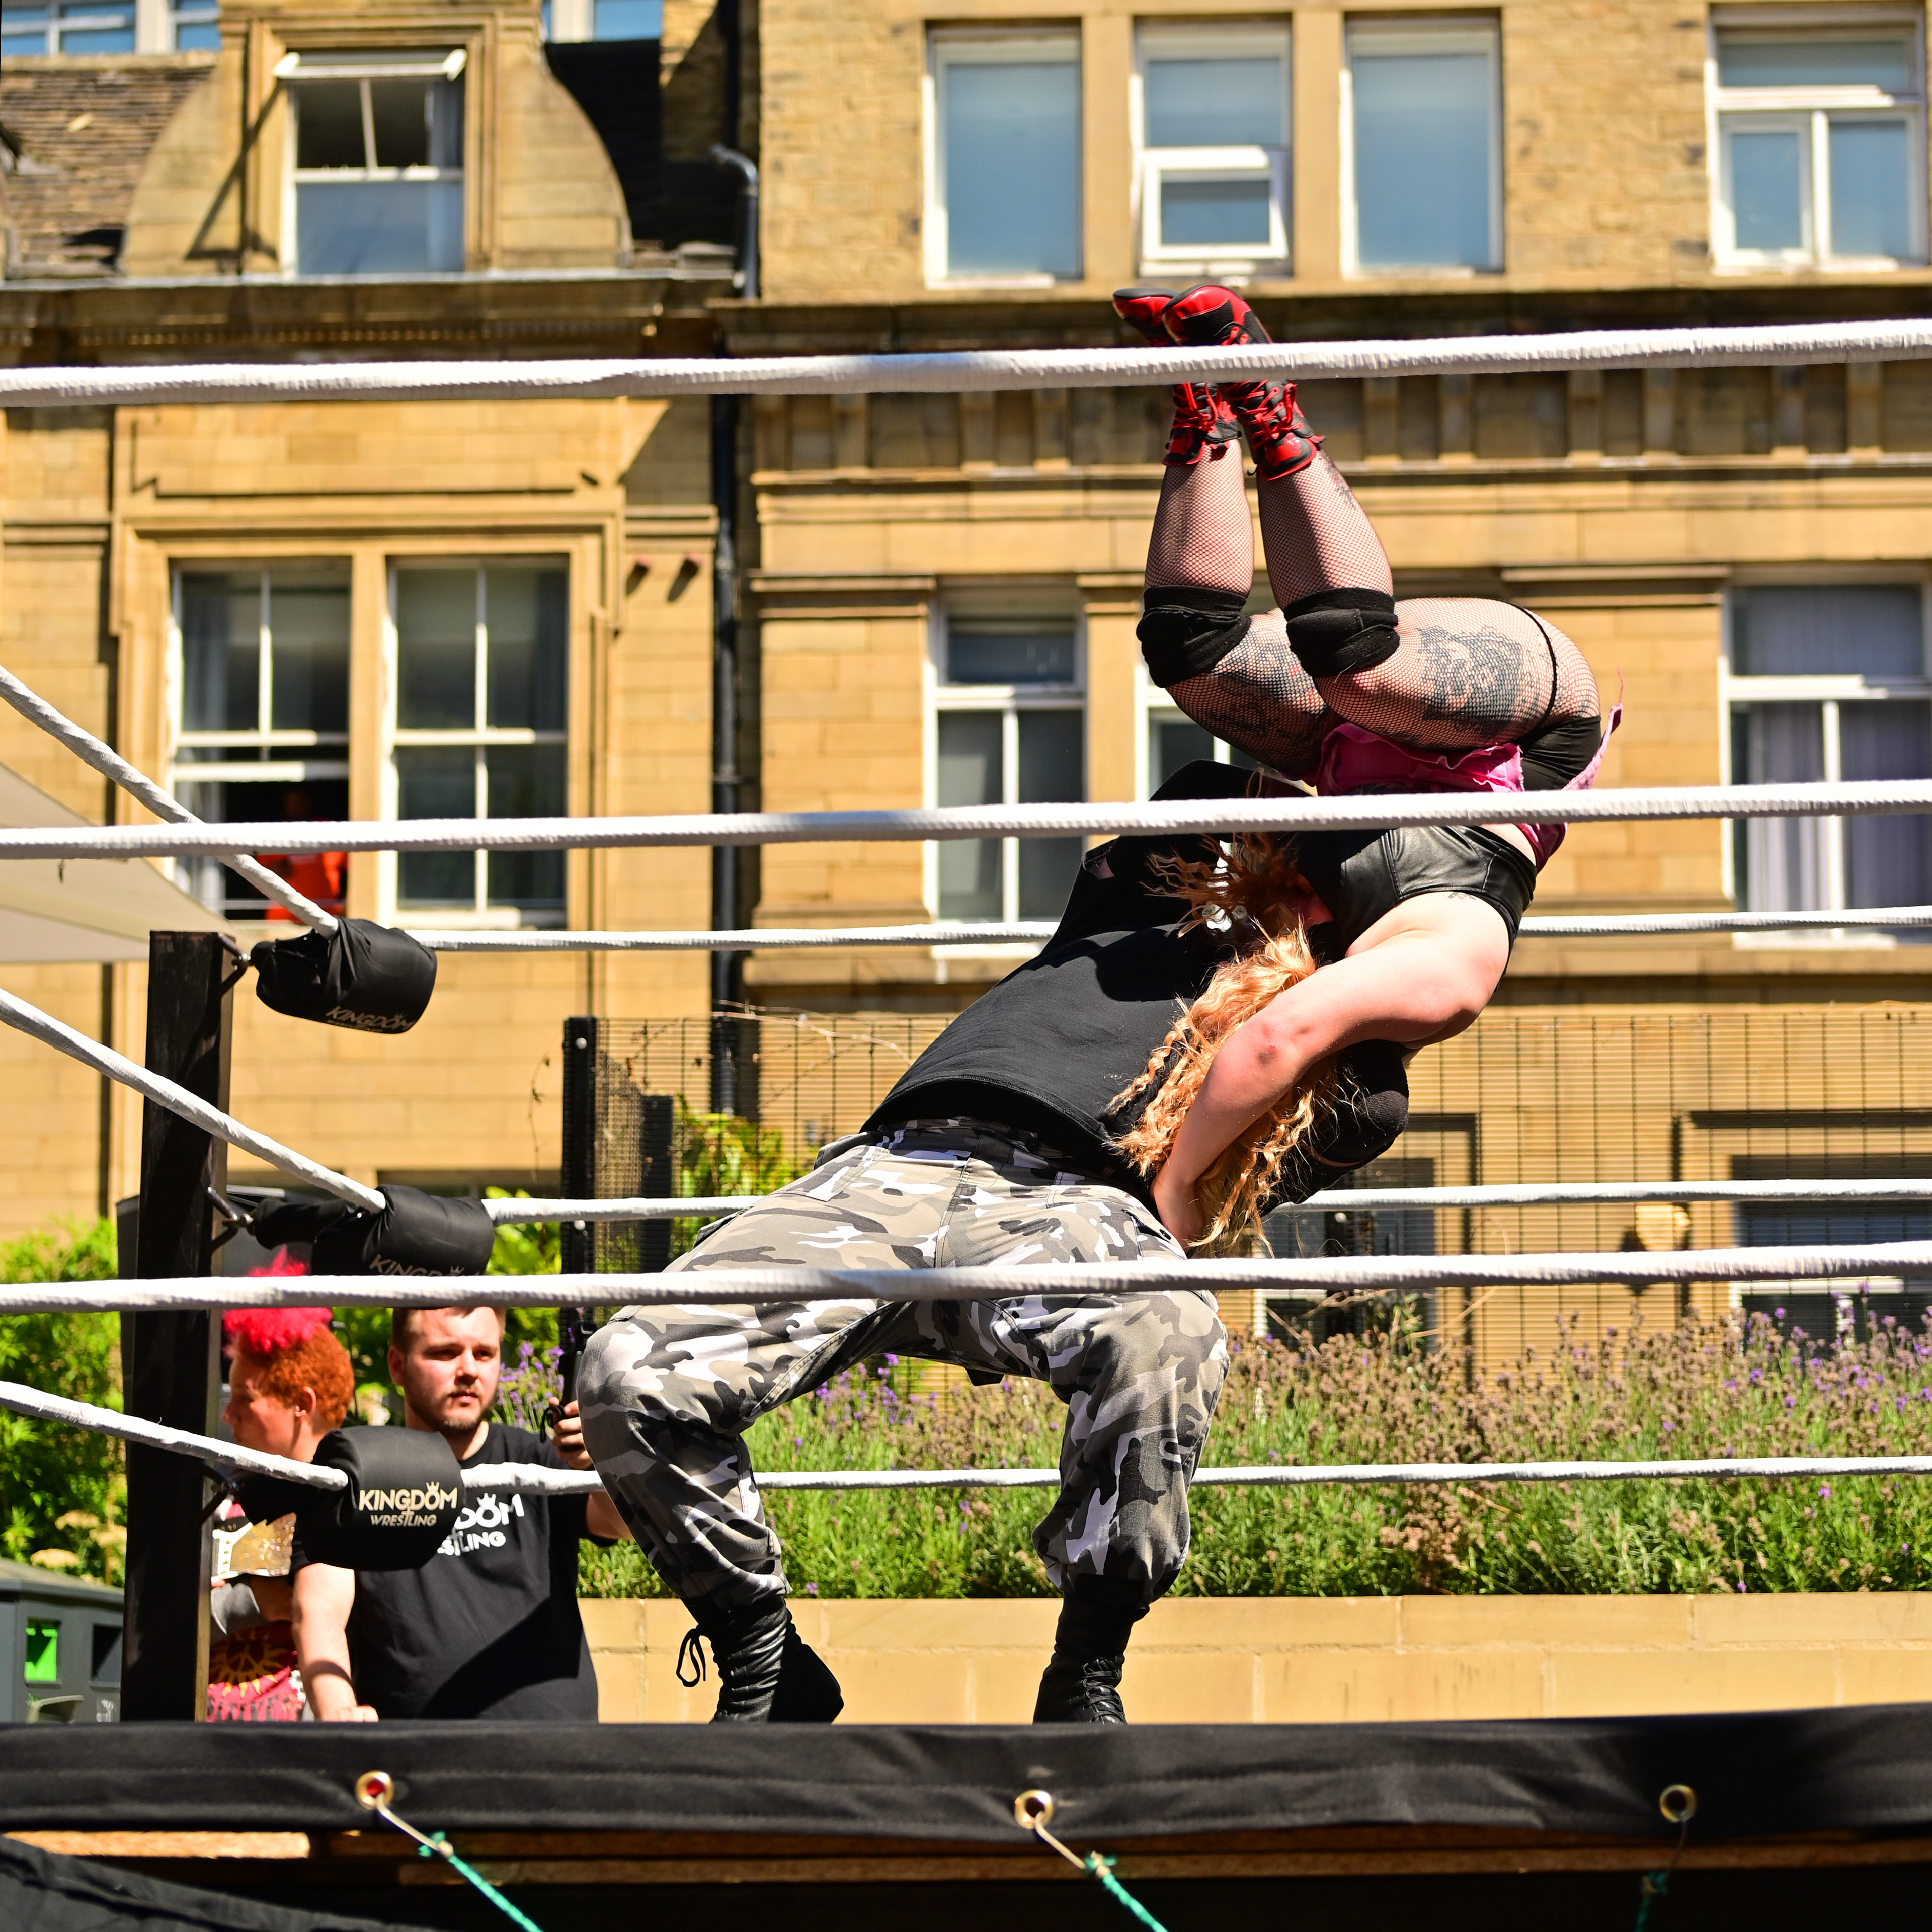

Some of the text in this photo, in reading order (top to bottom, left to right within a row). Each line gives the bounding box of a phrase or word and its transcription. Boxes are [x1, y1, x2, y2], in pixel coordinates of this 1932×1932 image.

[359, 1482, 457, 1511] KINGDOM
[370, 1512, 437, 1527] WRESTLING
[437, 1531, 506, 1556] STLING
